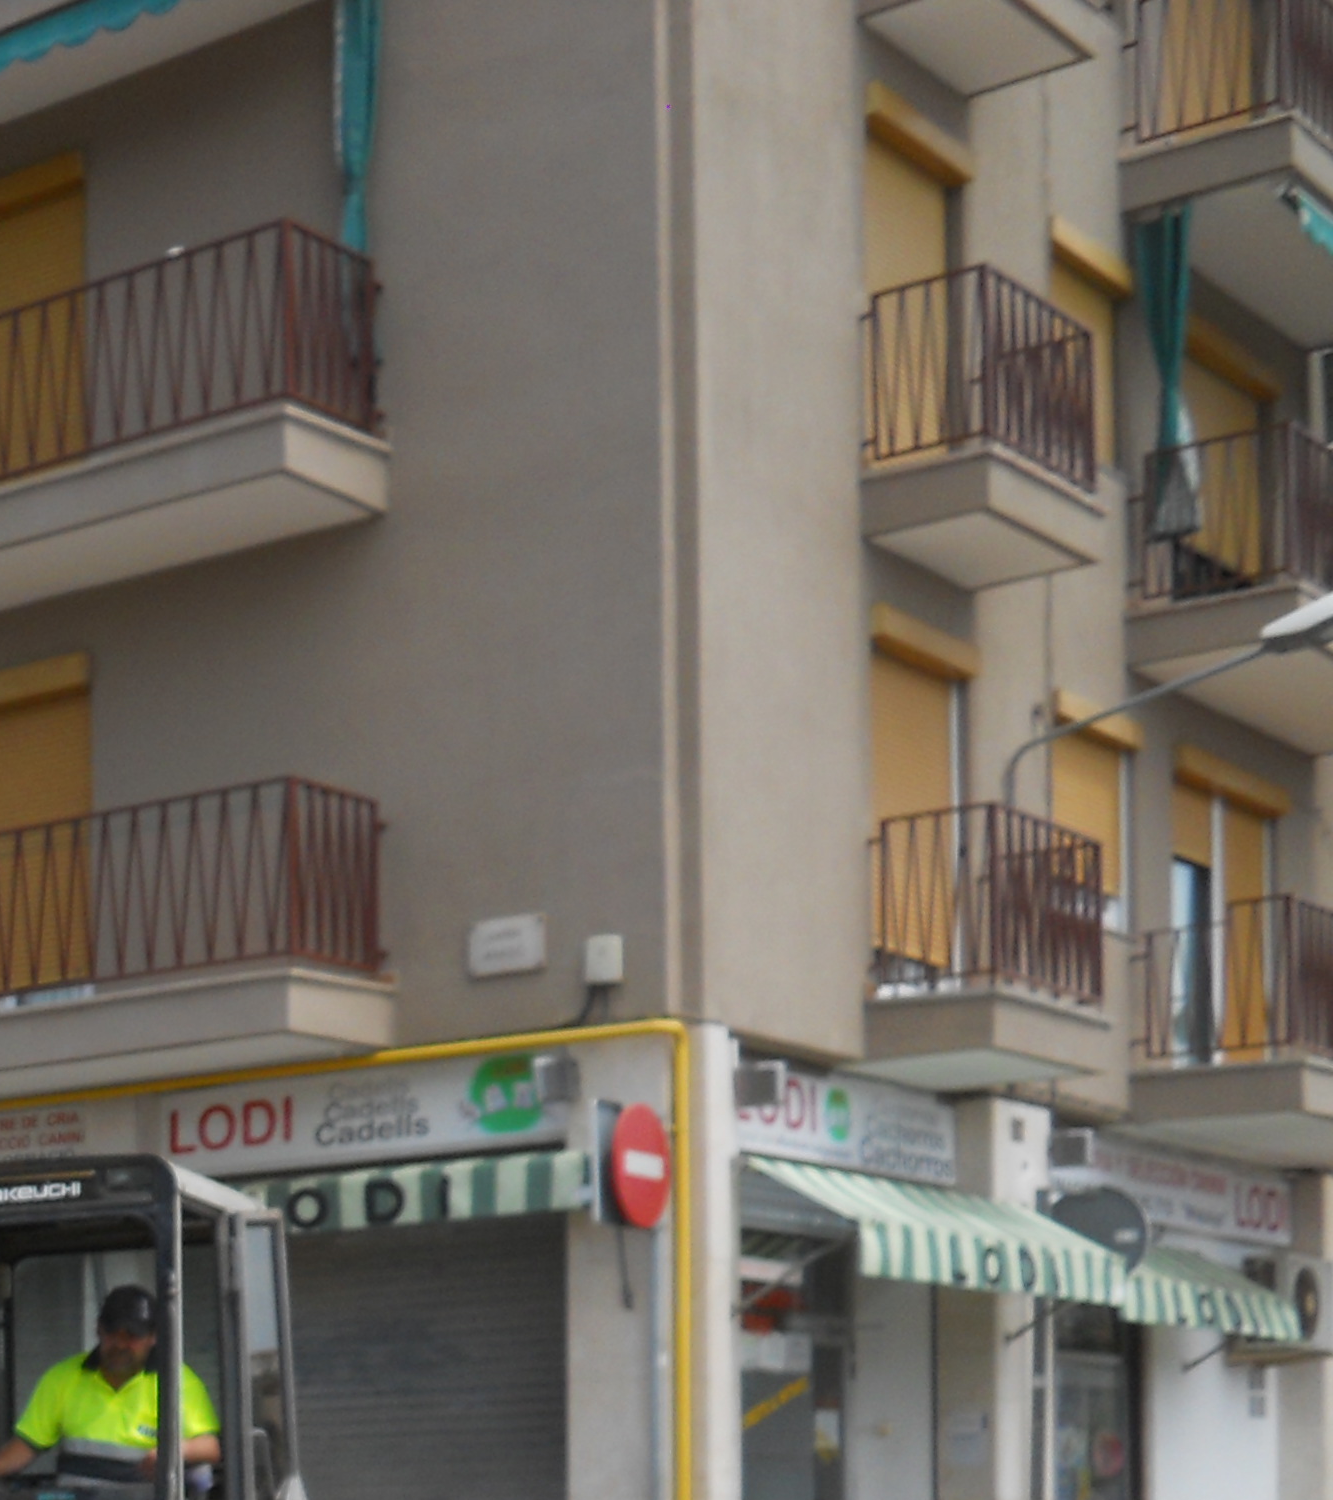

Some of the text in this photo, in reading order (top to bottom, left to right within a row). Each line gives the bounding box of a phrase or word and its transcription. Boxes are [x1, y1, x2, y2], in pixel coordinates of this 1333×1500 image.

[169, 1096, 294, 1155] LODI
[314, 1113, 430, 1147] Cadells
[323, 1094, 420, 1123] Cadells
[285, 1172, 451, 1229] ODI
[1234, 1181, 1290, 1234] LODI
[949, 1232, 1060, 1293] LODI
